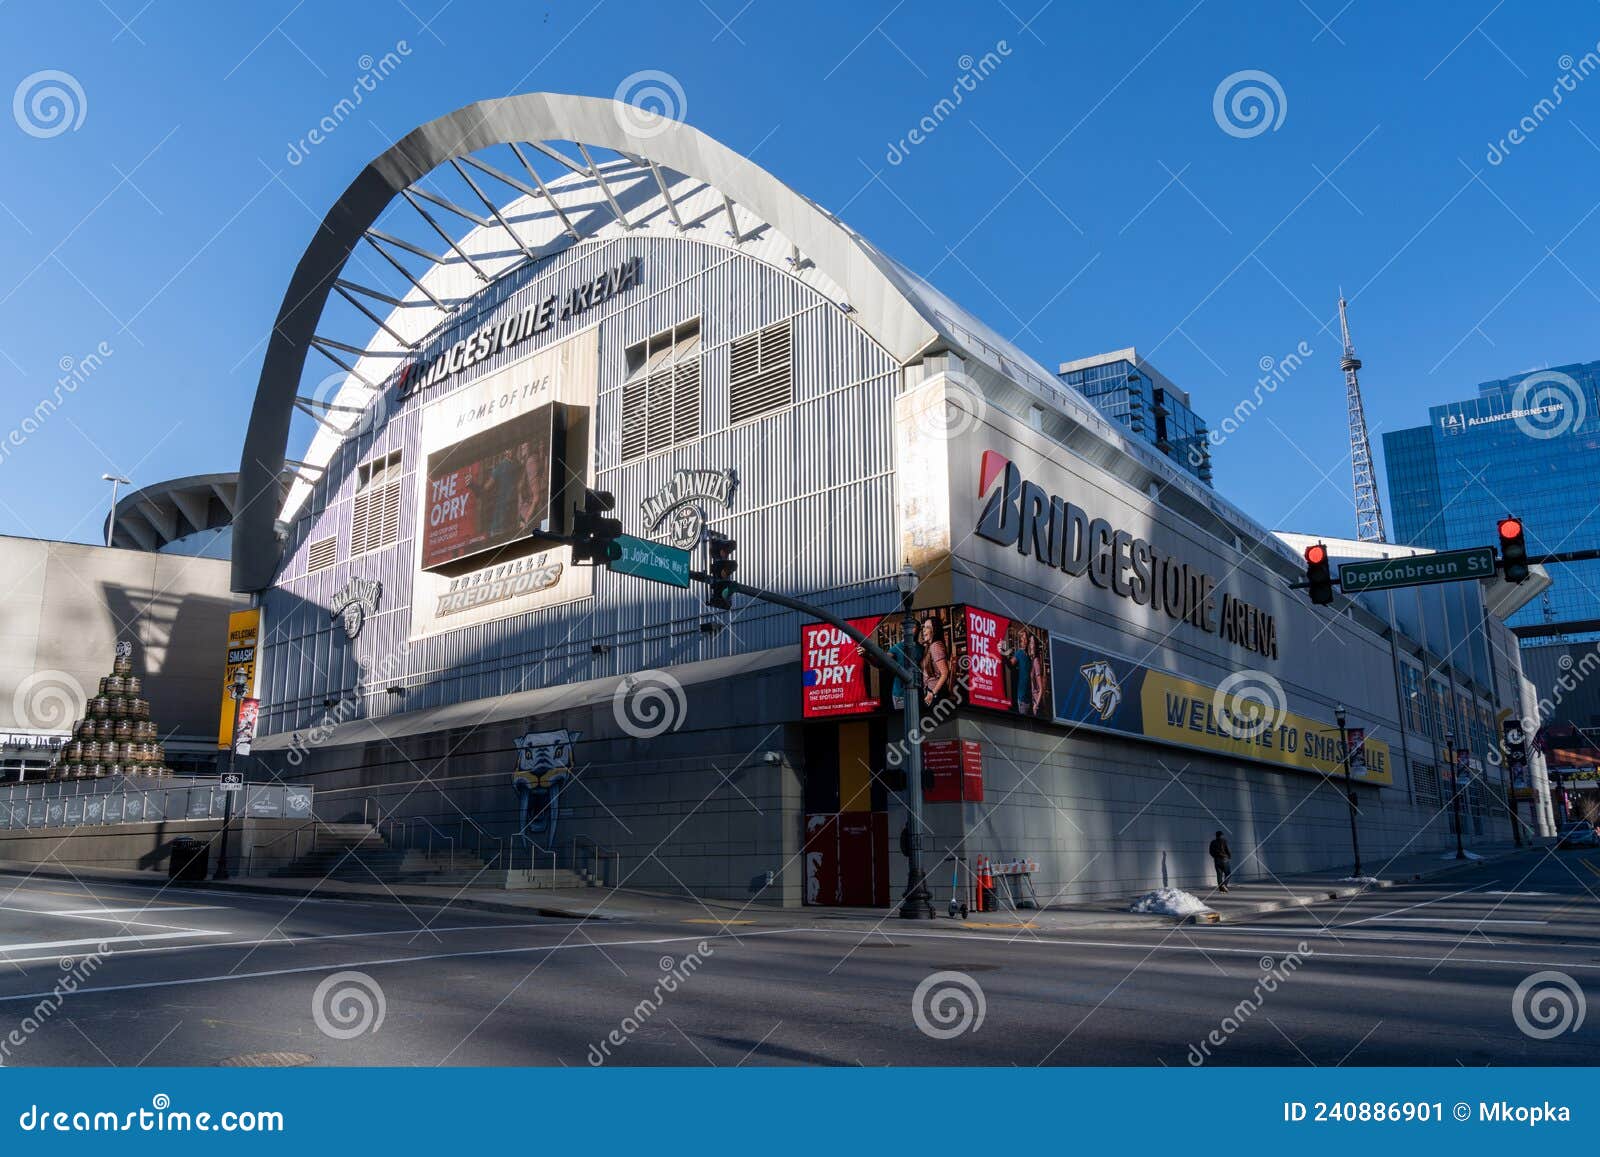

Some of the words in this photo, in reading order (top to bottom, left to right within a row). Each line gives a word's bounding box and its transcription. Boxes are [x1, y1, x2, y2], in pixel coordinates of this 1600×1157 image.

[398, 295, 556, 402] BRIDGESTONE
[560, 256, 642, 321] ARENA
[456, 398, 495, 428] HOME
[499, 390, 518, 411] OF
[522, 376, 550, 400] THE
[432, 473, 459, 503] THE
[430, 493, 469, 527] OPRY
[642, 482, 677, 528] JACK
[974, 450, 1217, 634] BRIDGESTONE
[1220, 593, 1279, 660] ARENA
[1346, 561, 1458, 585] Demonbreun
[1467, 555, 1488, 571] St
[437, 563, 562, 618] PREDATORS
[969, 612, 997, 638] TOUR
[228, 649, 254, 663] SMASH
[808, 647, 840, 668] THE
[970, 633, 990, 656] THE
[971, 655, 998, 677] OPRY
[1279, 725, 1298, 753] TO
[1303, 731, 1385, 774] SMASLLE
